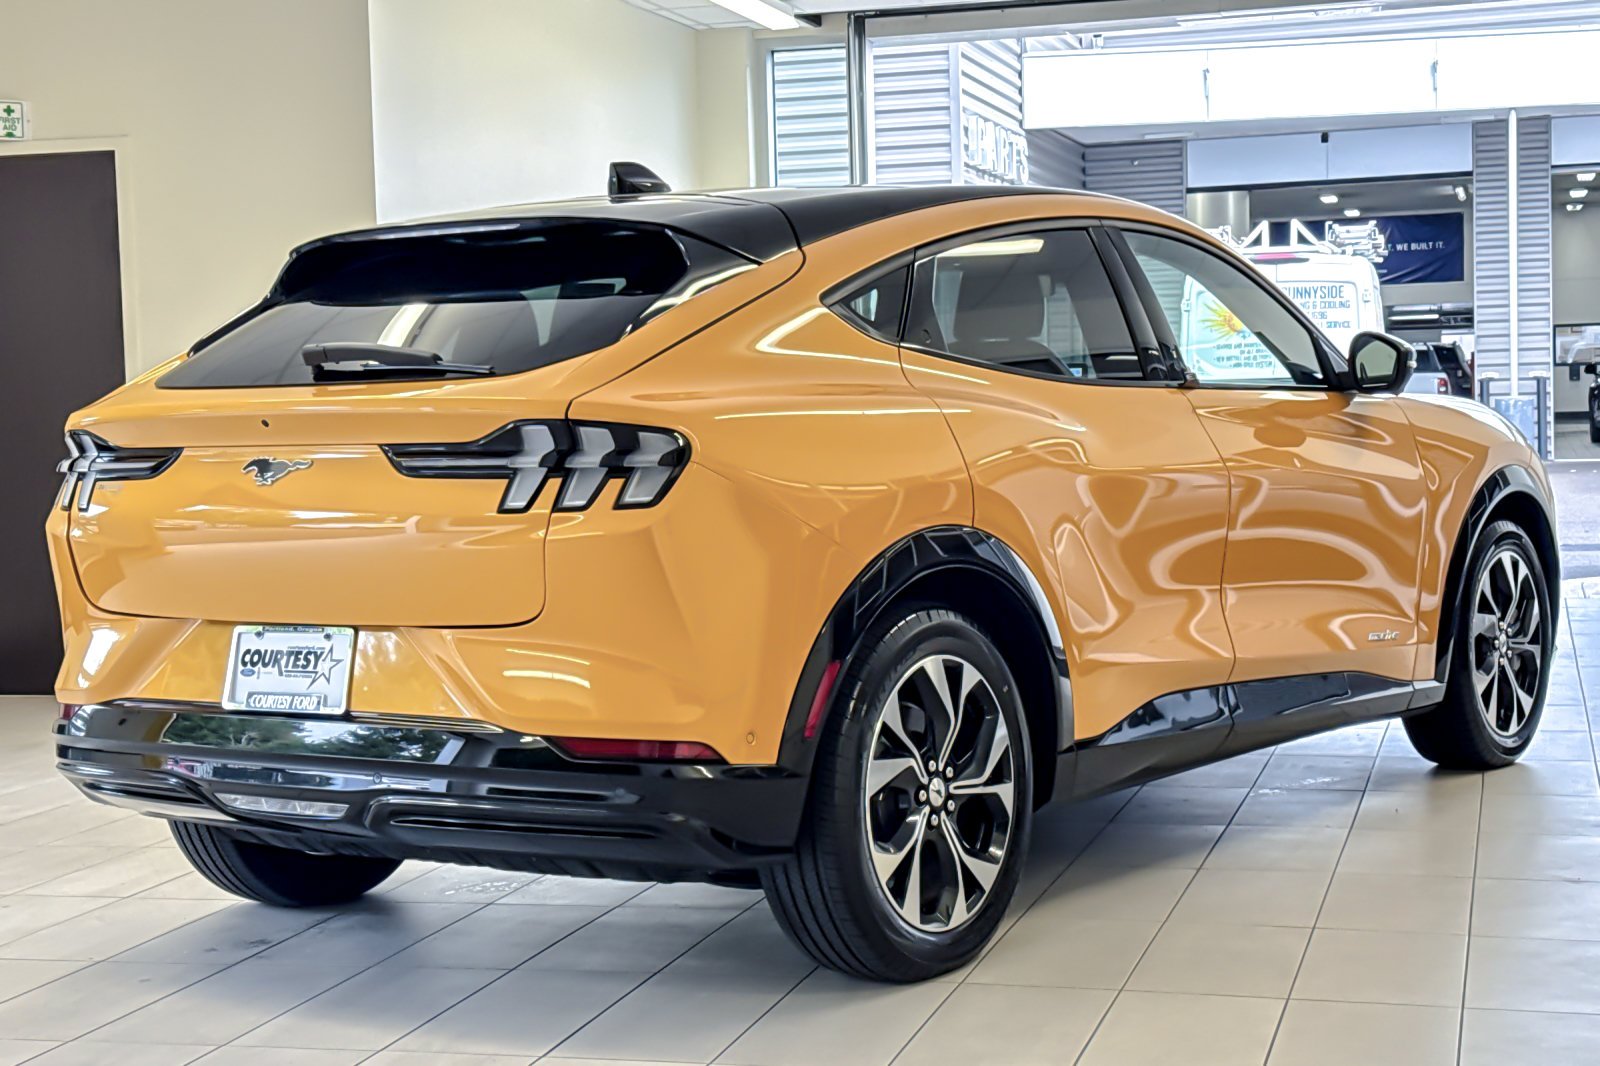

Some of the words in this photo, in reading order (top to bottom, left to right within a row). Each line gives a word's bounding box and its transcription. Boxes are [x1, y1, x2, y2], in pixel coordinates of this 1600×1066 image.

[1396, 243, 1409, 251] WE
[1411, 242, 1433, 251] BUILT
[1435, 241, 1445, 249] IT.
[241, 649, 326, 677] COURTESY
[250, 694, 292, 709] COURTESY
[292, 694, 319, 710] FORD
